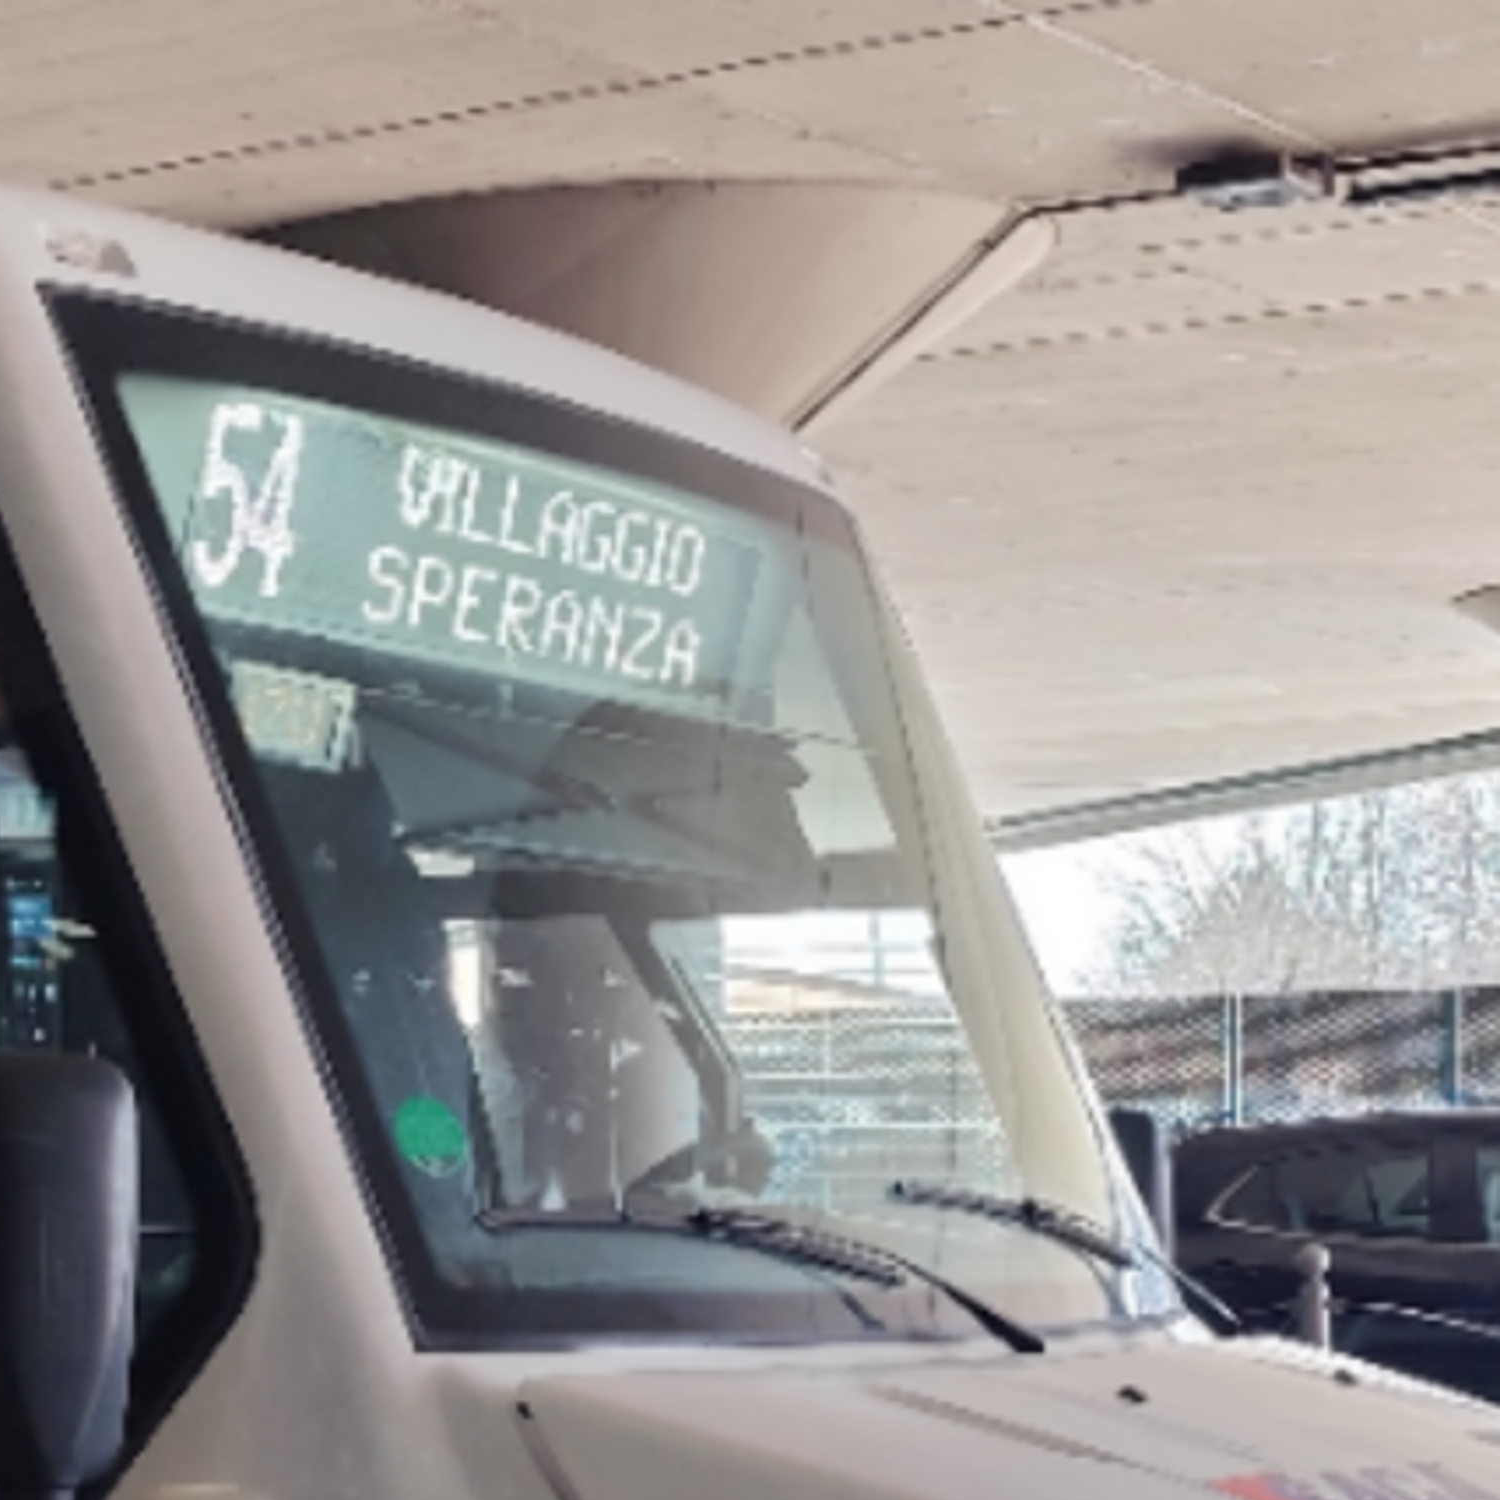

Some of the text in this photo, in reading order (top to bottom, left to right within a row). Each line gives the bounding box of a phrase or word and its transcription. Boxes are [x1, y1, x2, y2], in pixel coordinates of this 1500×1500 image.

[193, 402, 305, 597] 54
[398, 447, 704, 596] VILLAGGIO
[363, 546, 701, 687] SPERANZA
